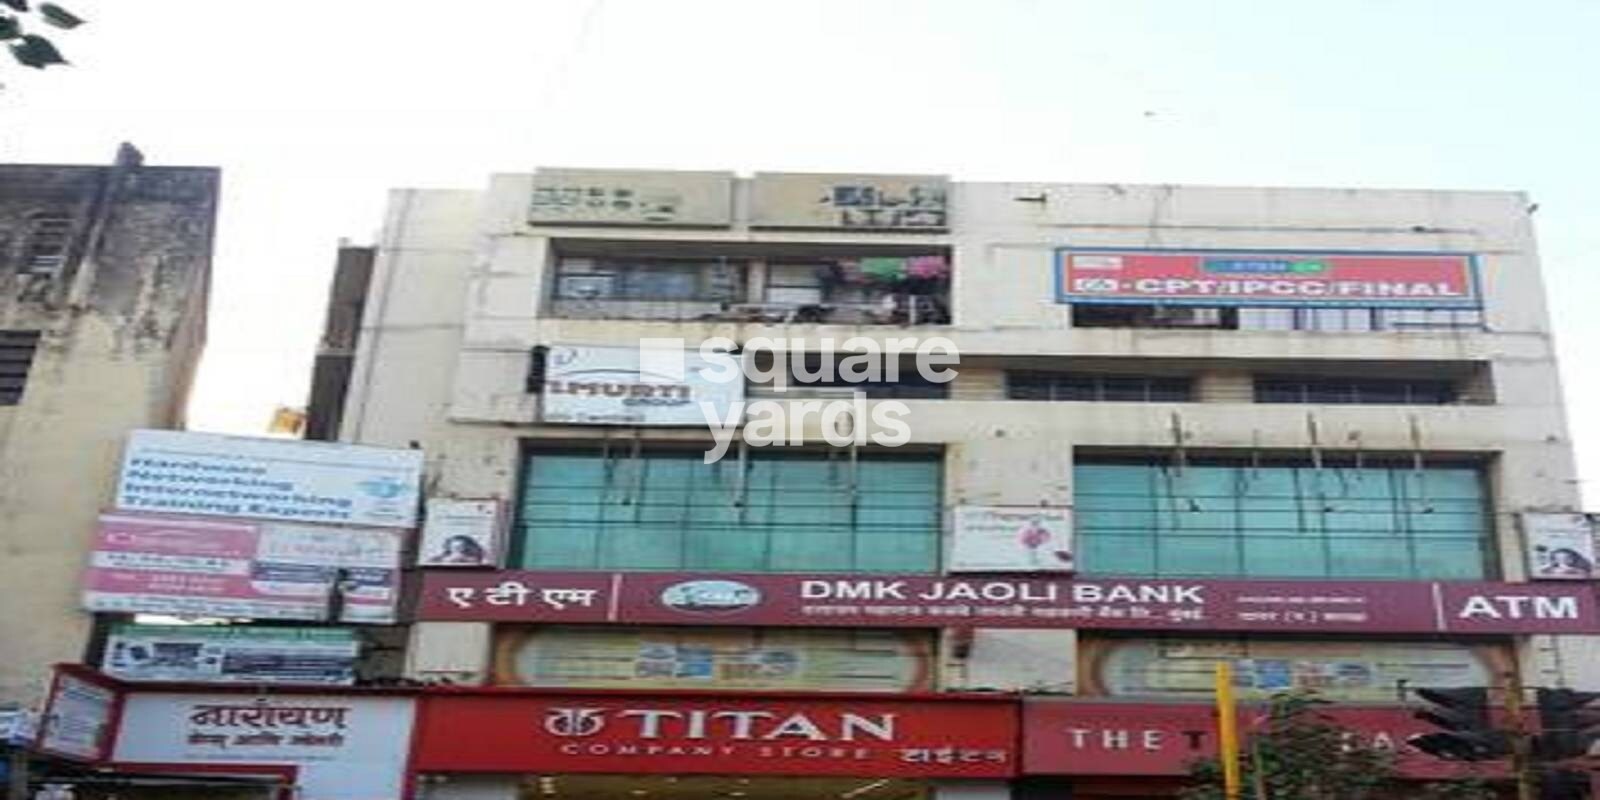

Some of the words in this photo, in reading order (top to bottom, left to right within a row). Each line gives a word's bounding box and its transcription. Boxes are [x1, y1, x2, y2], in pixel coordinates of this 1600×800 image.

[126, 469, 294, 491] Networking
[446, 587, 474, 609] ए
[483, 581, 529, 606] टी
[542, 588, 597, 610] एम
[801, 580, 907, 599] DMK
[918, 581, 1058, 601] JAOLI
[1072, 584, 1205, 604] BANK
[1459, 596, 1579, 620] ATM
[617, 709, 897, 741] TITAN
[559, 743, 734, 757] COMPANY
[759, 747, 870, 760] STORE
[1069, 728, 1165, 752] THE
